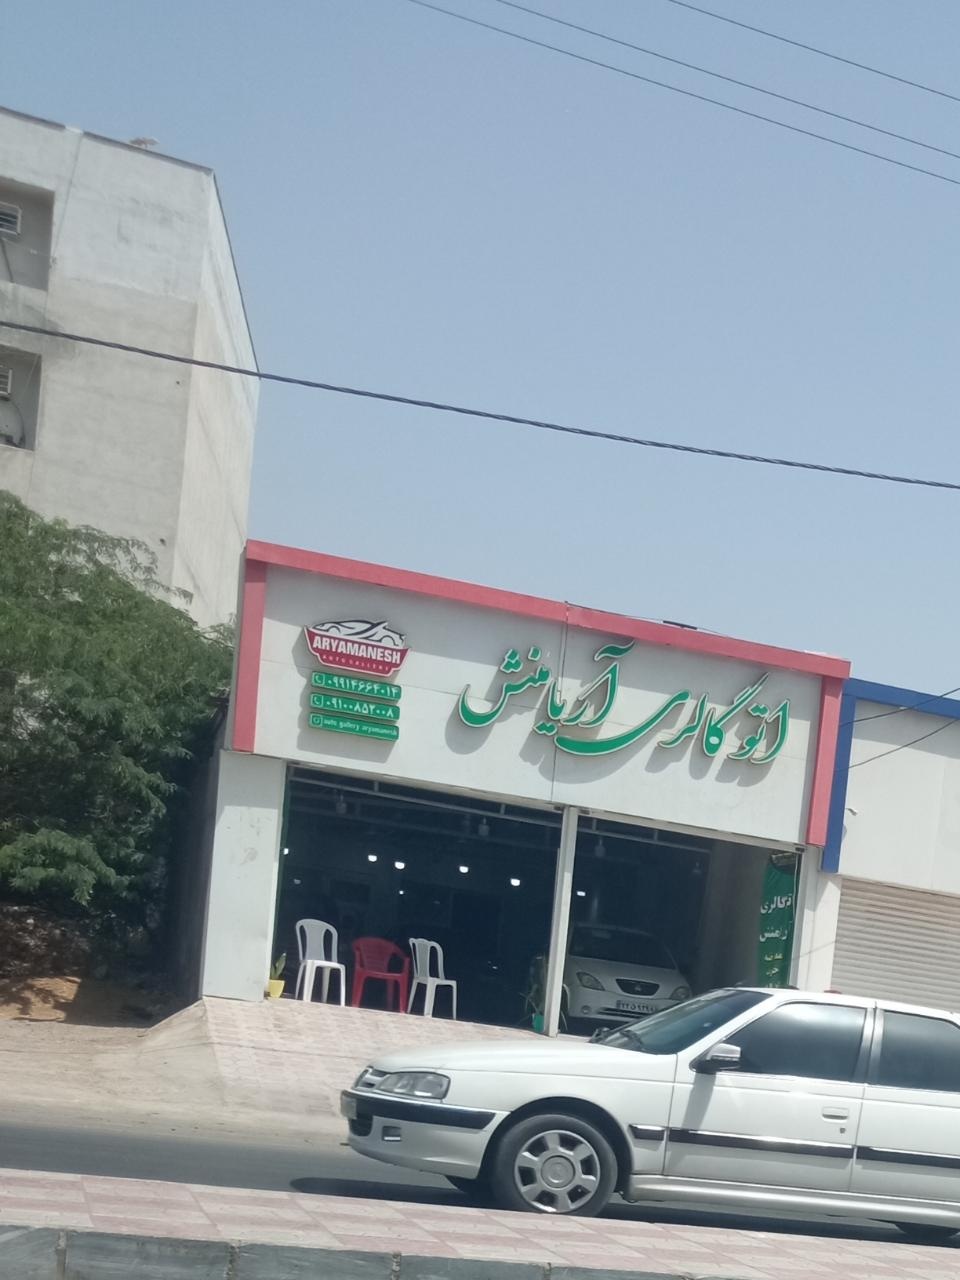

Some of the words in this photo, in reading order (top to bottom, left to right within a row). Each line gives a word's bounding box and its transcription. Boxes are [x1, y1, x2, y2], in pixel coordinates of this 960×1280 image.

[313, 636, 401, 665] ARYAMANESH
[457, 639, 636, 736] آریامنش
[554, 671, 770, 757] گالری
[727, 698, 790, 763] اتو
